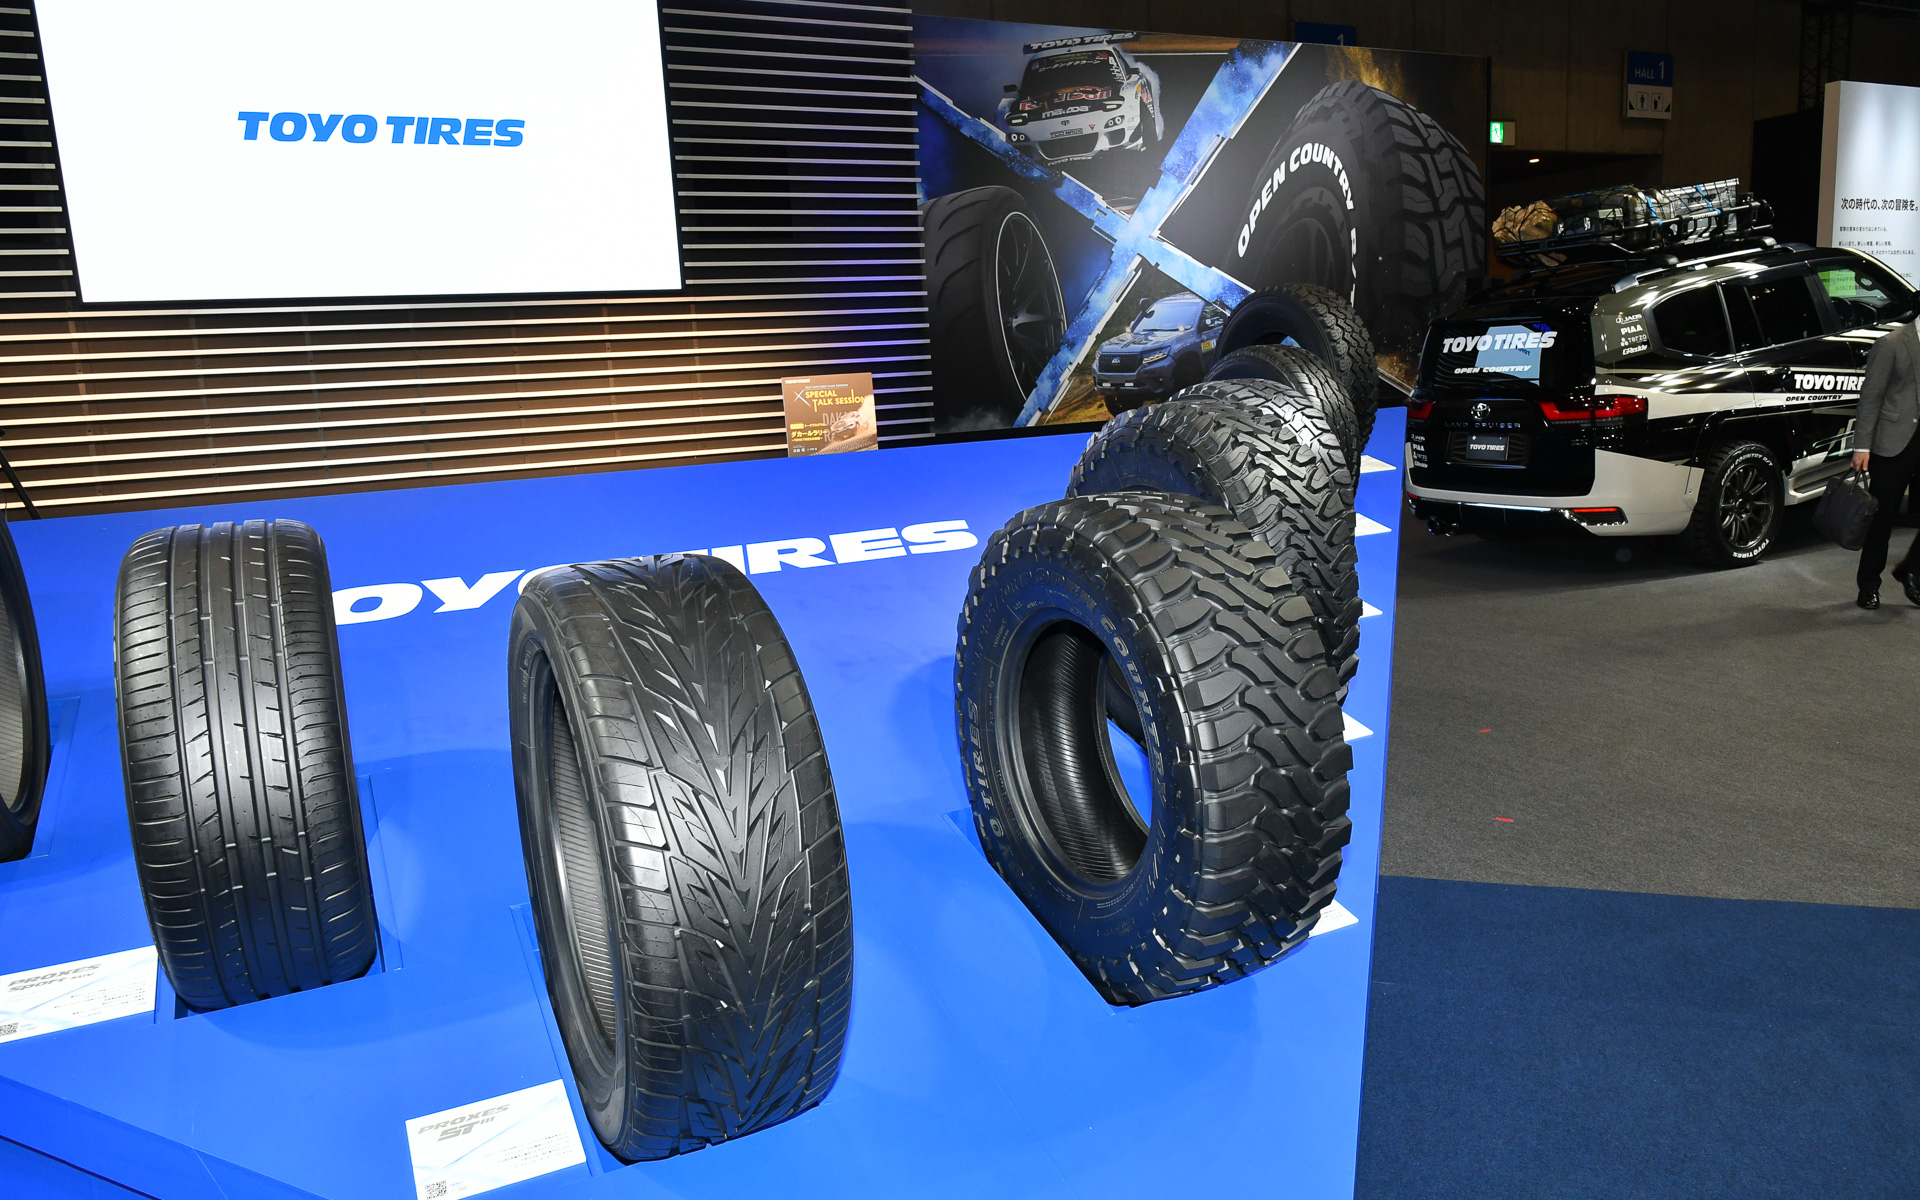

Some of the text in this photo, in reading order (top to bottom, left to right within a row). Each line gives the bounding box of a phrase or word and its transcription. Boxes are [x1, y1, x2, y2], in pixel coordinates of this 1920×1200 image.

[1030, 31, 1136, 50] TOYO TIRES
[1634, 61, 1666, 80] HALL 1
[237, 111, 526, 148] TOYO TIRES
[1237, 160, 1286, 258] OPEN
[1290, 142, 1354, 211] COUNTRY
[1840, 198, 1919, 212] 次の時代の、次の冒険を。
[1620, 324, 1643, 335] PIAA
[1443, 331, 1558, 353] TOYO TIRES
[1482, 365, 1532, 373] COUNTRY
[1794, 373, 1866, 391] TOYO TIRE
[805, 389, 837, 399] SPECIAL
[812, 388, 866, 412] TALK SESSION
[791, 429, 829, 438] ダカールラリー
[1753, 538, 1770, 556] TOYO
[967, 698, 995, 811] TIRES
[7, 963, 102, 986] PROXES
[418, 1104, 511, 1135] PROXES
